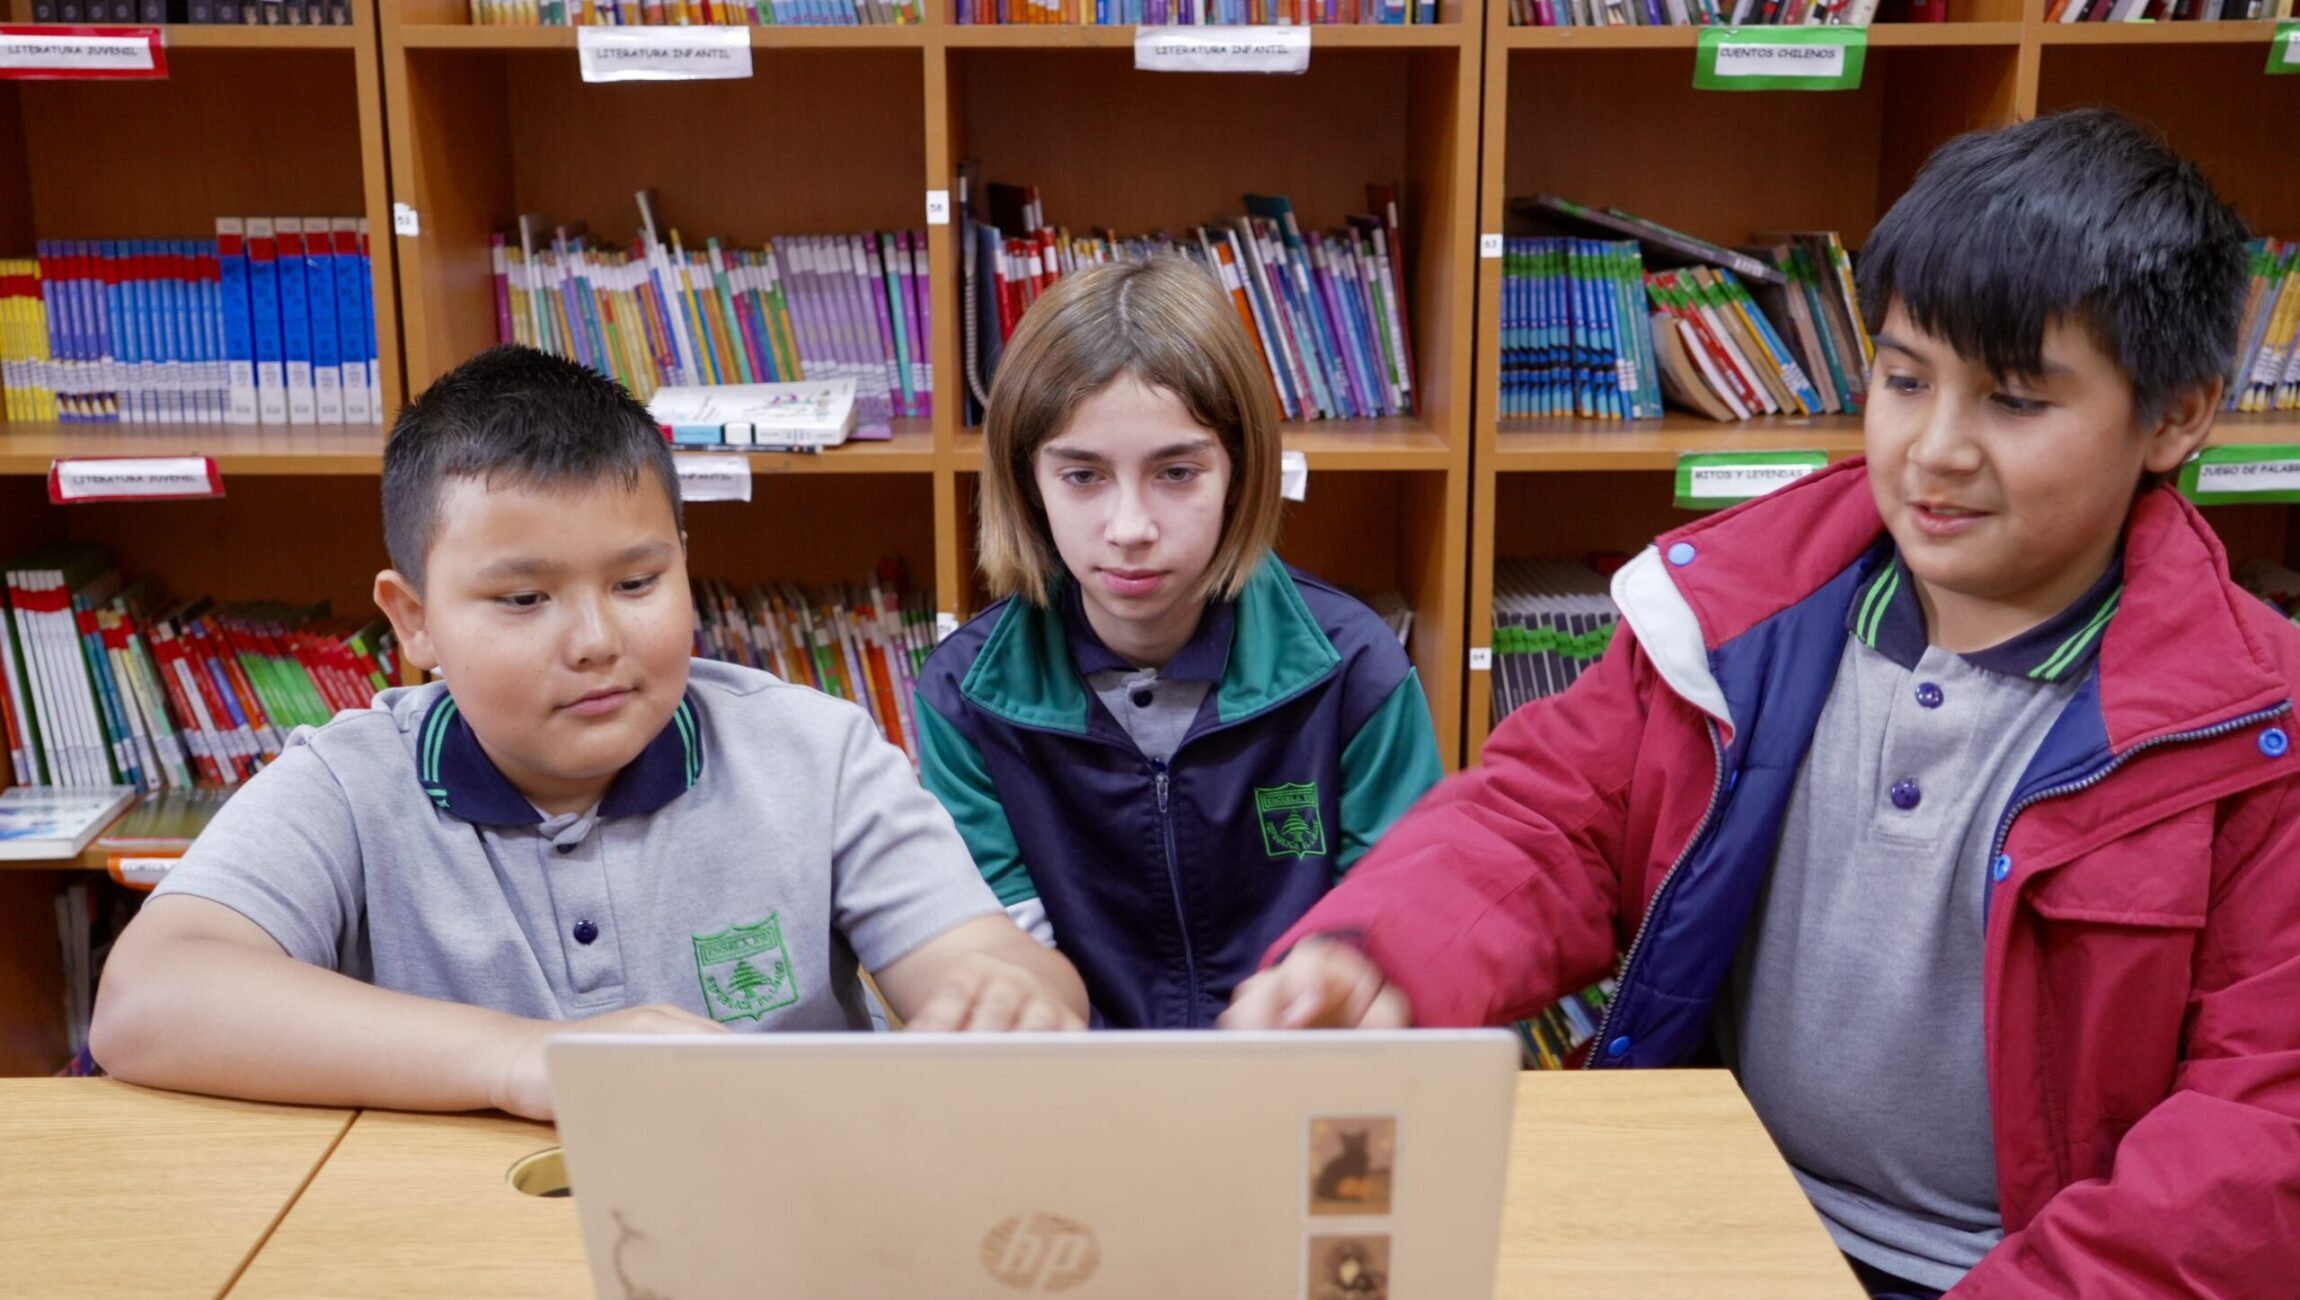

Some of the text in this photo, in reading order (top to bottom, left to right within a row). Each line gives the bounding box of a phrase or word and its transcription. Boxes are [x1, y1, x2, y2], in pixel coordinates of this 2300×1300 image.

[8, 45, 138, 57] LITERATURA JUVENIL
[596, 48, 731, 59] LITERATURA INFANTIL
[1155, 45, 1290, 56] LITERATURA INFANTIL
[1720, 47, 1835, 60] CUENTOS CHILENOS
[1485, 239, 1497, 249] 63
[1694, 469, 1803, 480] MITOS Y LEYENDAS
[2202, 465, 2240, 477] JUEGO
[2243, 465, 2257, 475] DE
[73, 475, 197, 485] LITERATURA JUVENIL
[998, 1214, 1089, 1292] hp
